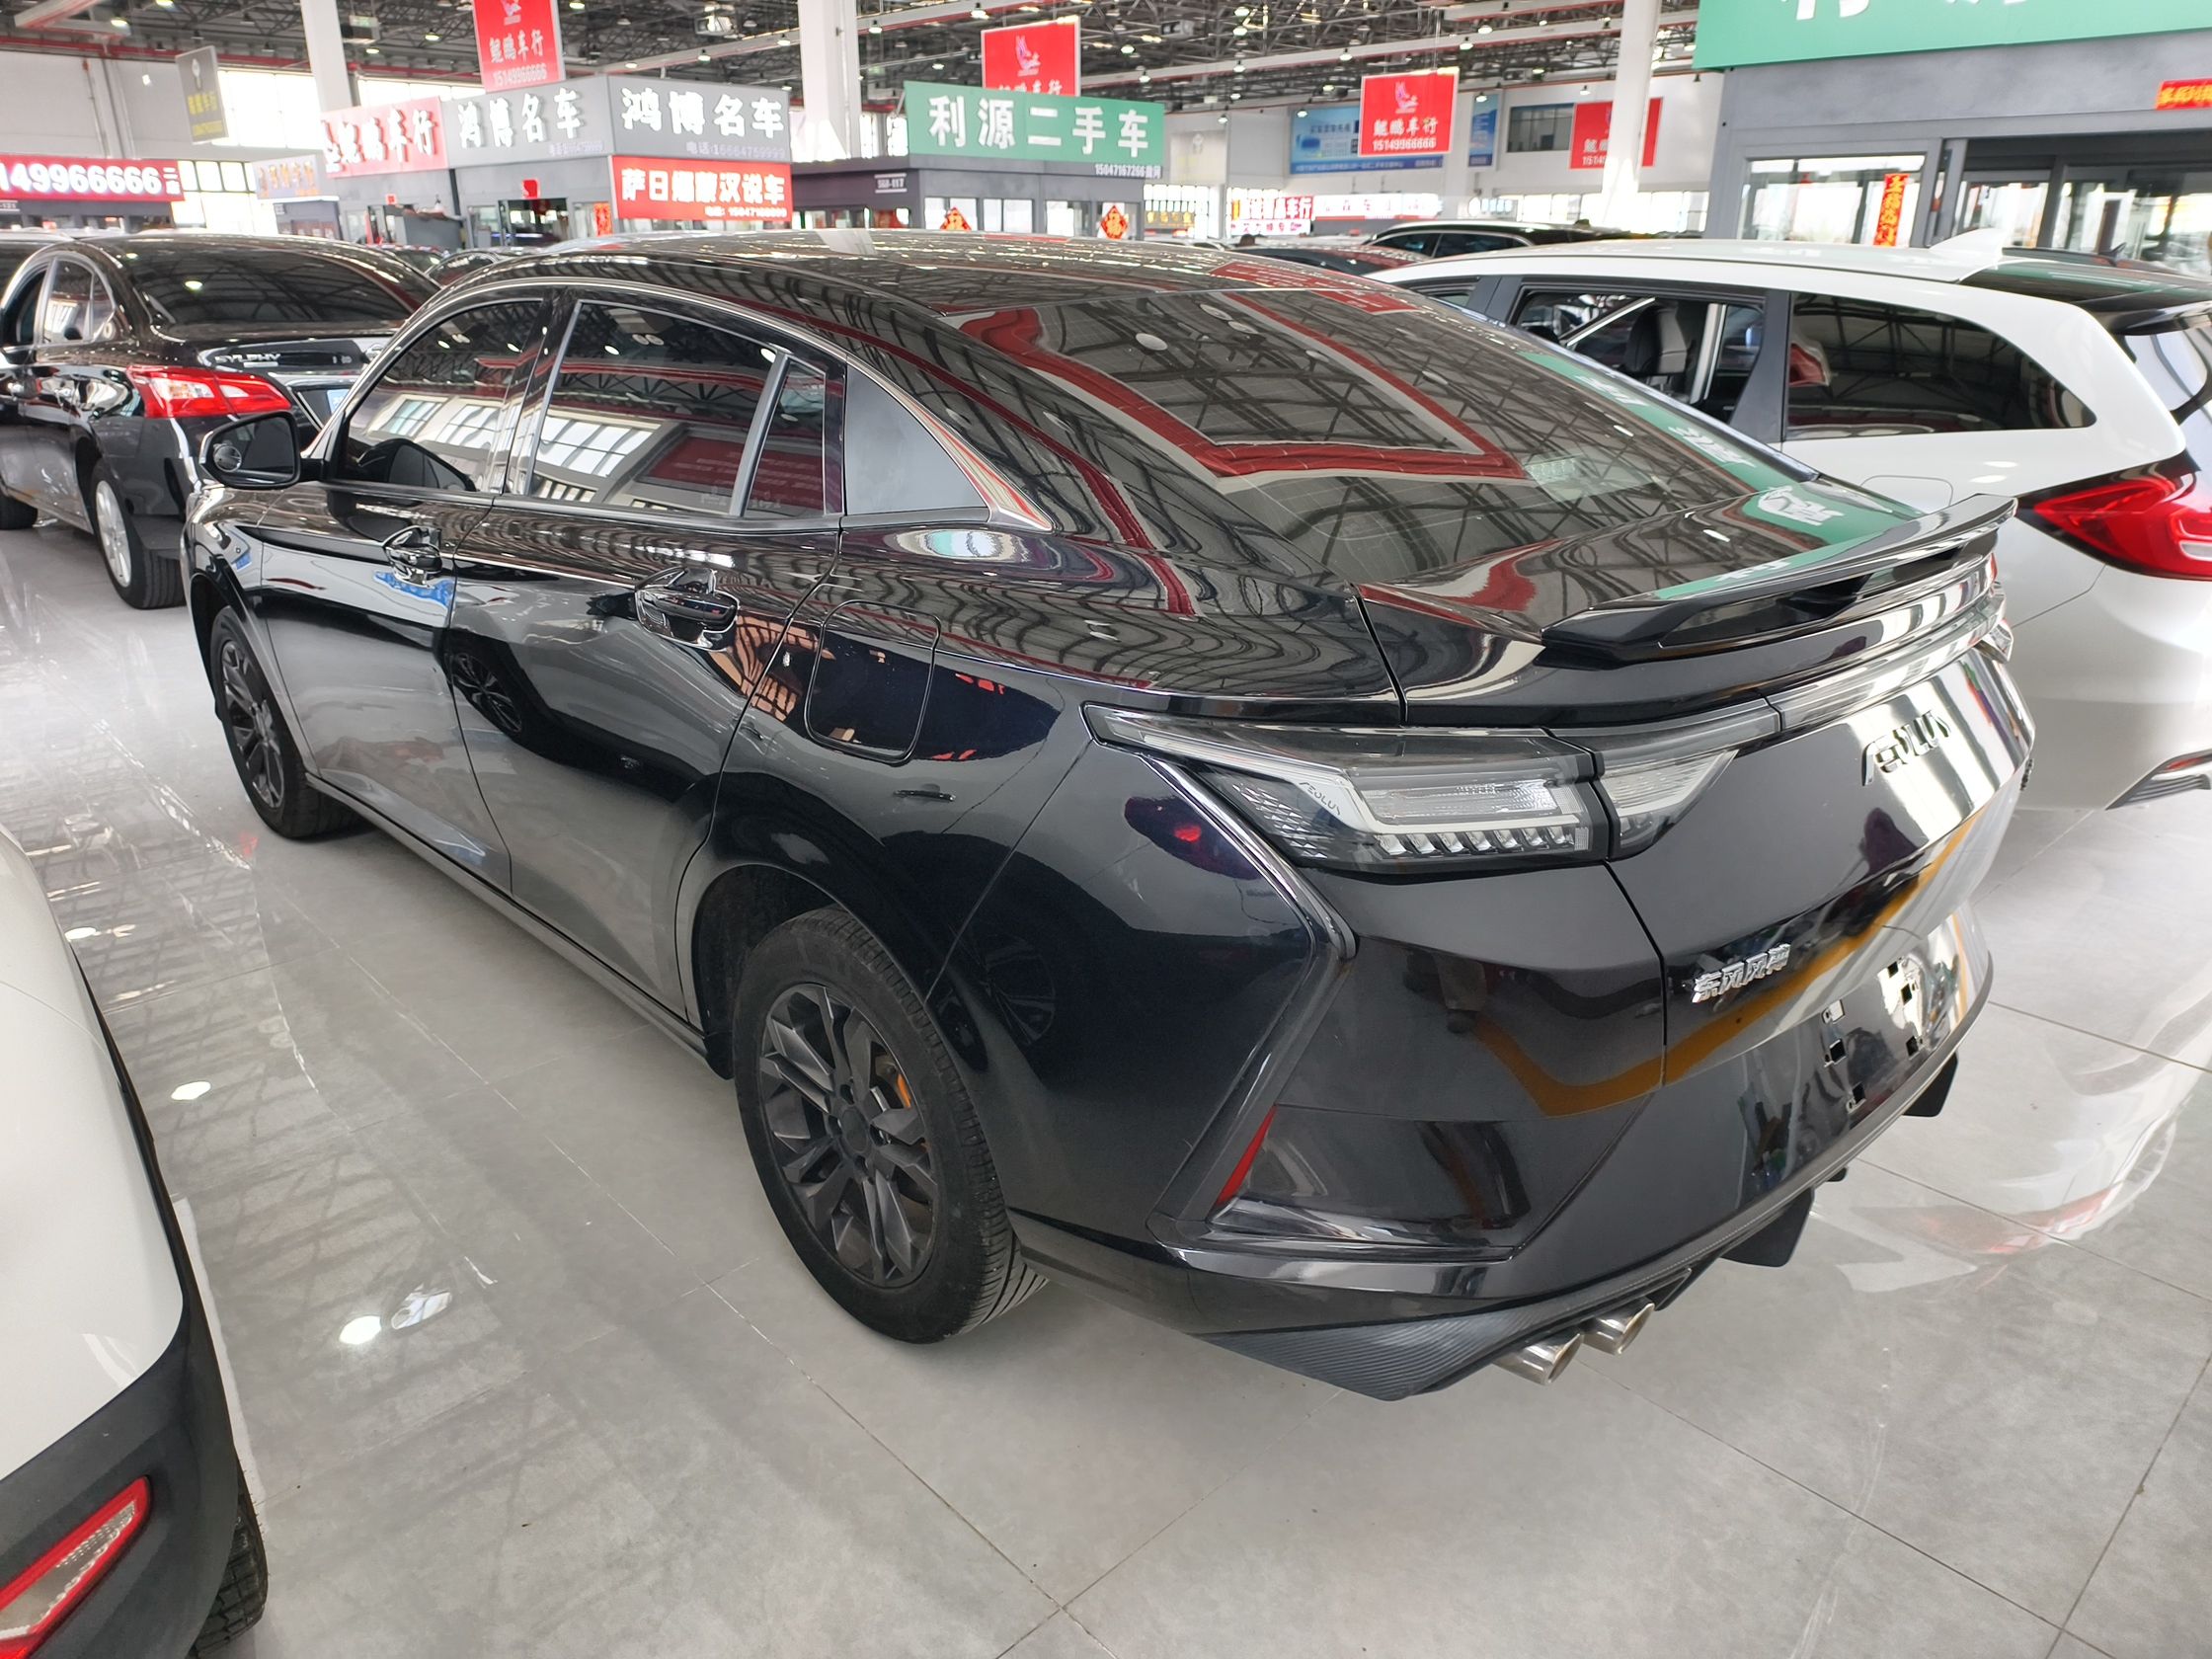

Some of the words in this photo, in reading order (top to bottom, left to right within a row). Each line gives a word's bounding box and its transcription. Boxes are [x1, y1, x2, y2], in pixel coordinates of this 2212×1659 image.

[621, 87, 785, 139] 鸿博名车
[928, 95, 1149, 158] 利源二手车
[214, 353, 281, 363] SYLPHY
